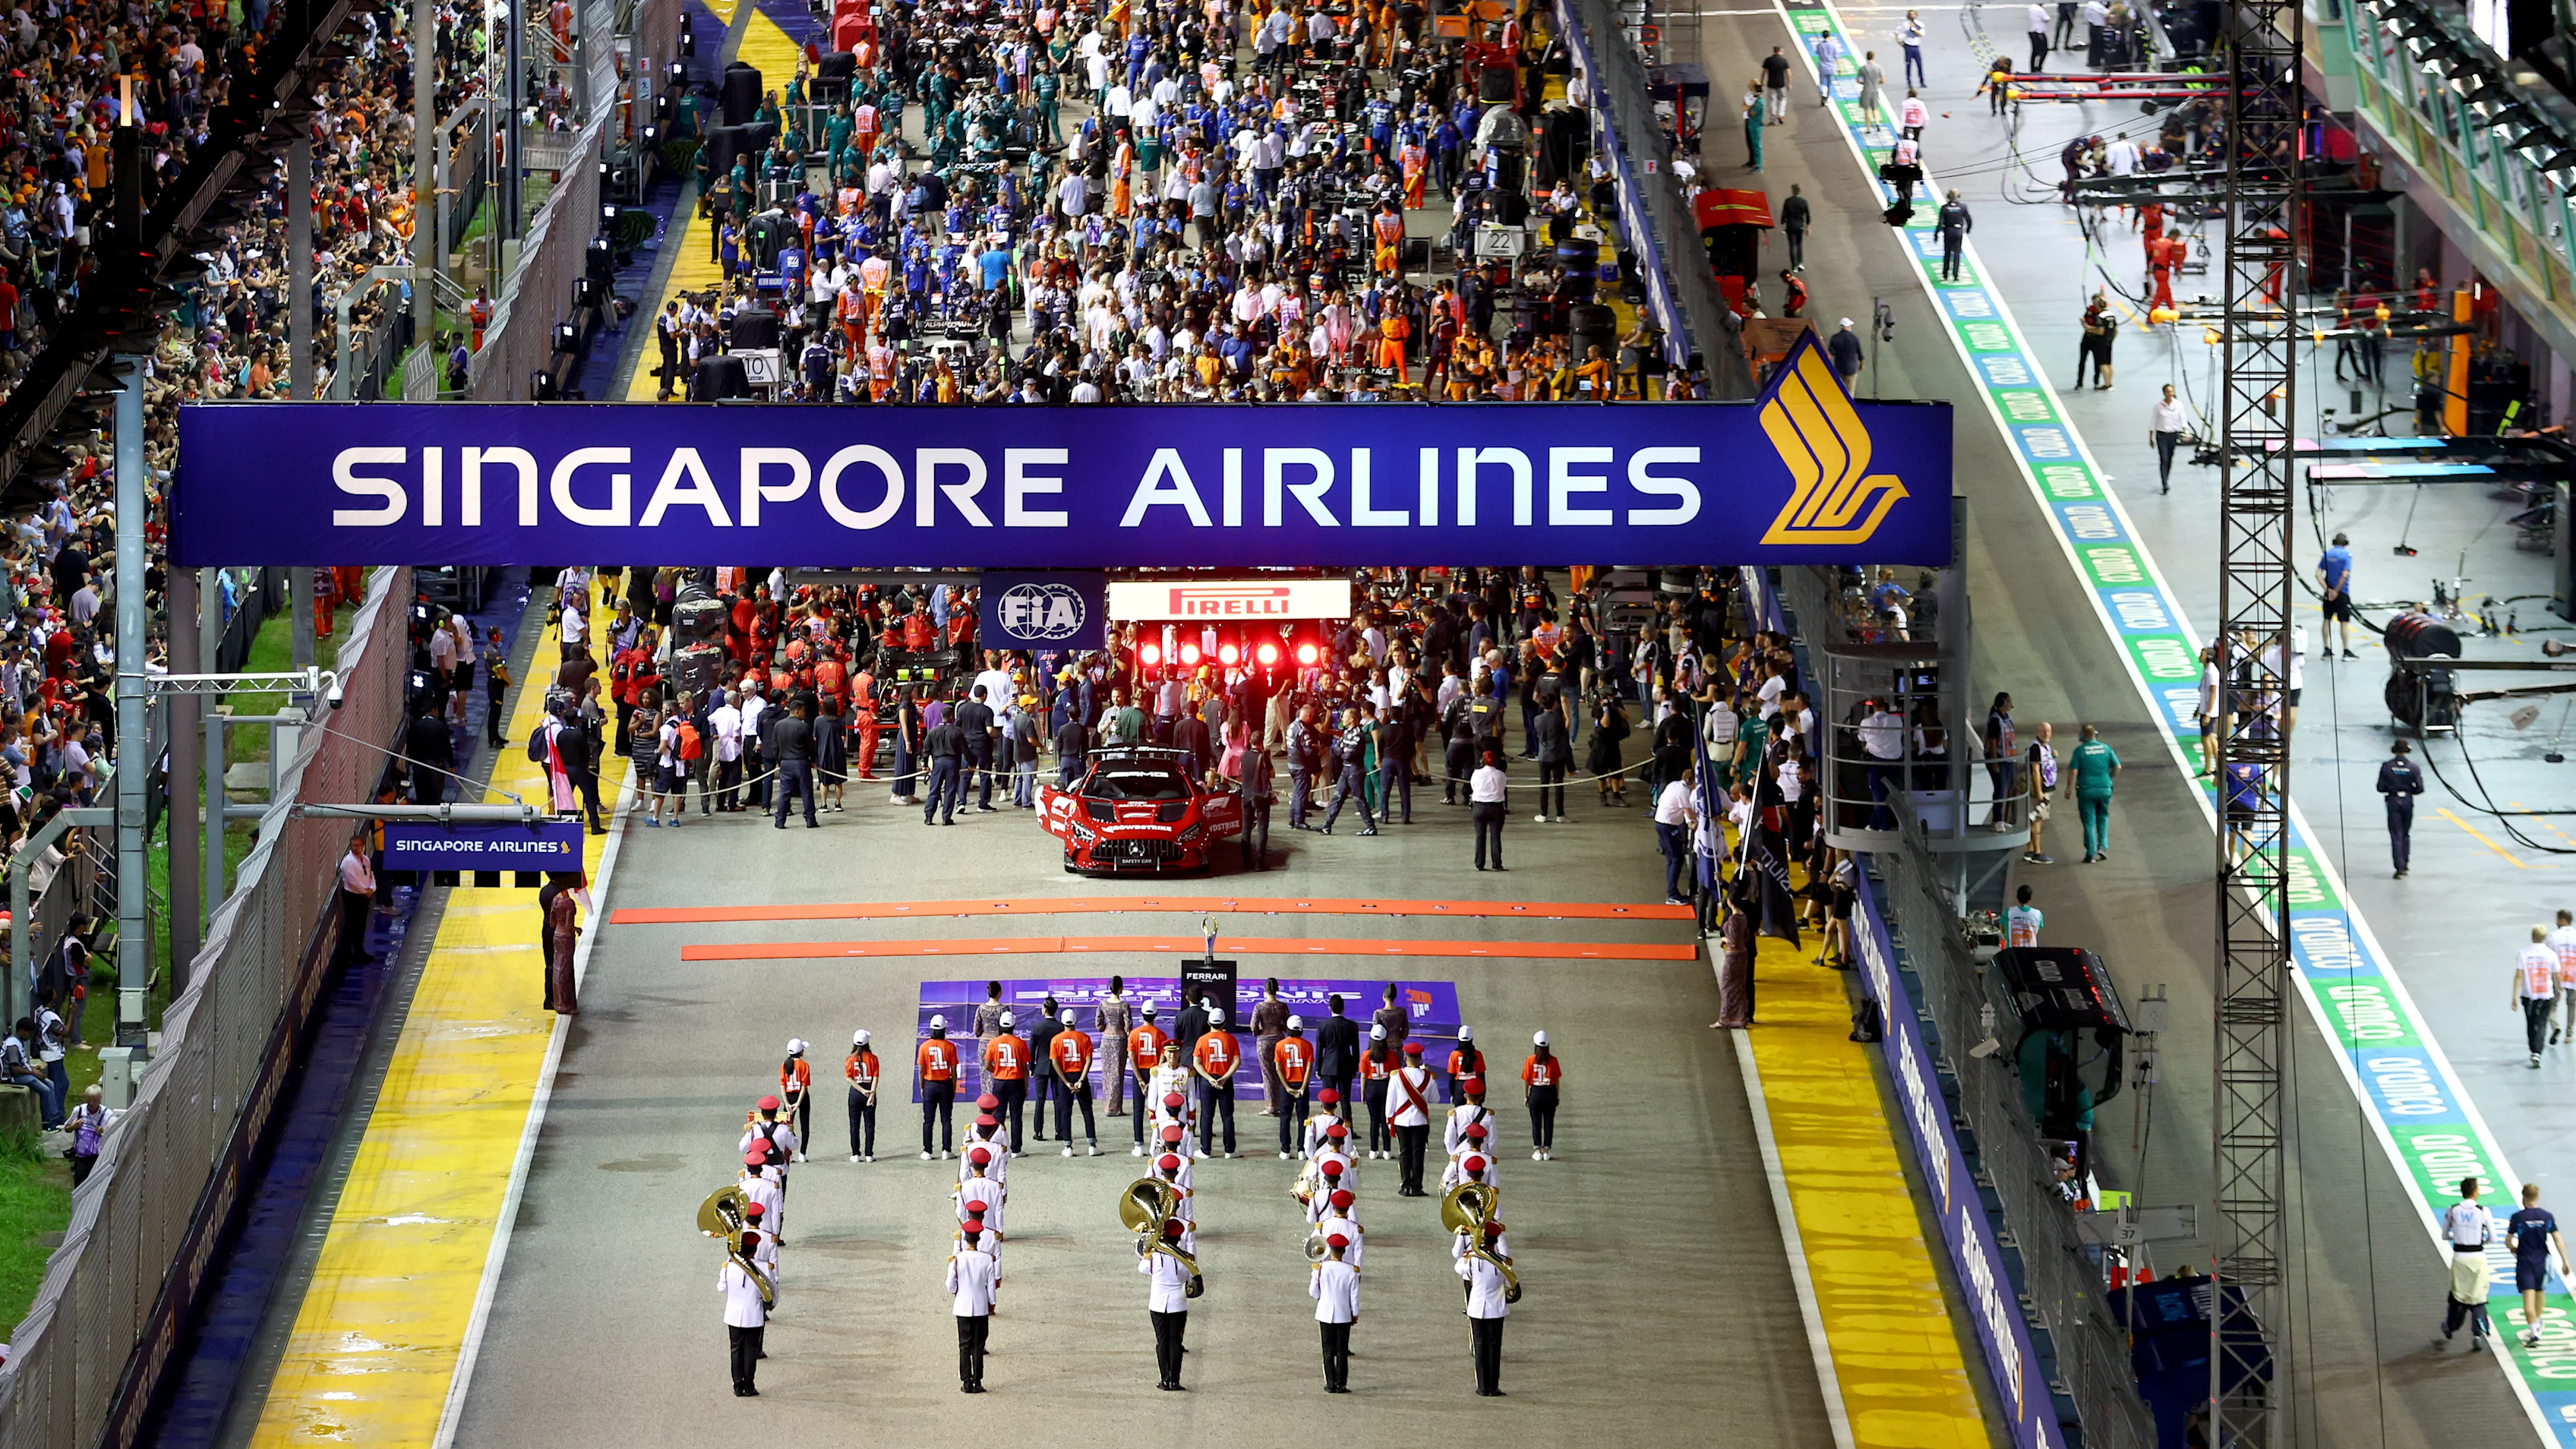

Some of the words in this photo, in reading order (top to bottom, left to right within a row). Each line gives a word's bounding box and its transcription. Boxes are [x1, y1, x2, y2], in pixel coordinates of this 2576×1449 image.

[1490, 233, 1510, 248] 22
[745, 358, 764, 374] 10
[332, 444, 1069, 530] SINGAPORE
[1118, 445, 1703, 527] AIRLINES
[1169, 587, 1290, 615] PIRELLI
[396, 840, 484, 852] SINGAPORE
[488, 840, 558, 853] AIRLINES
[2290, 917, 2365, 970] aramco
[1186, 972, 1227, 980] FERRARI
[2328, 985, 2405, 1040] aramco
[2367, 1056, 2448, 1116] aramco
[2410, 1134, 2495, 1197] aramco
[2120, 1230, 2136, 1239] 37
[1962, 1204, 1994, 1331] SINGAPORE
[1994, 1289, 2019, 1404] AIRLINES
[2506, 1306, 2576, 1379] aramco
